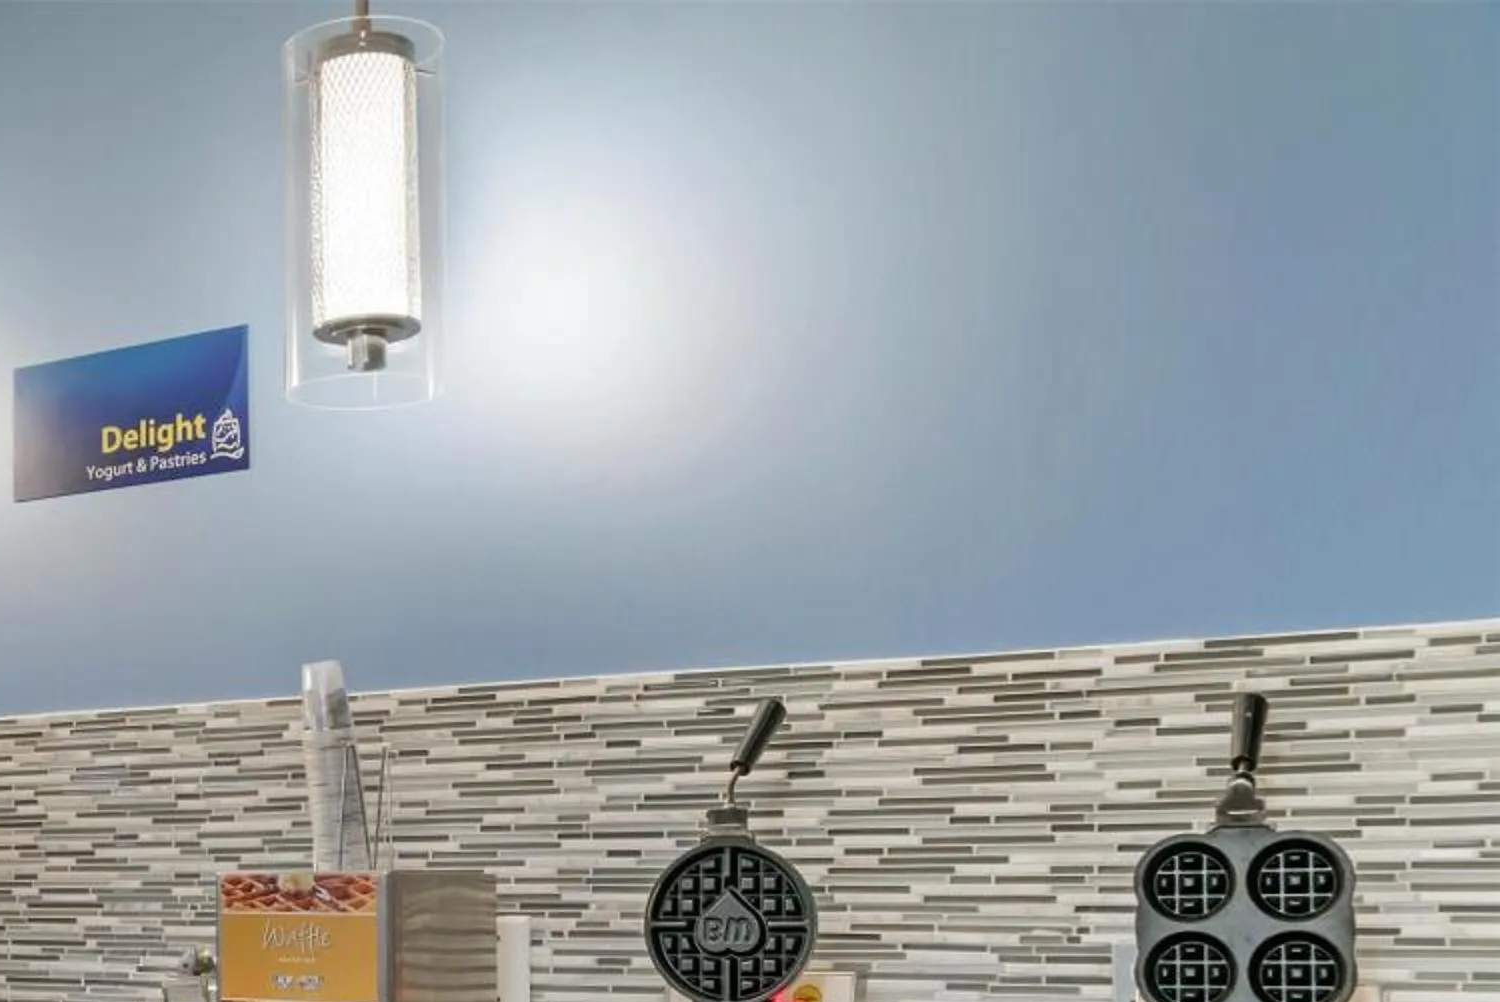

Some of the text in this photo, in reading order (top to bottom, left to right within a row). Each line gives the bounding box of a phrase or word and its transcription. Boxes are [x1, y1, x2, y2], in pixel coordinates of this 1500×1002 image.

[101, 413, 206, 453] Delight
[86, 451, 207, 481] Yogurt & Pastries
[261, 914, 331, 954] Waffle
